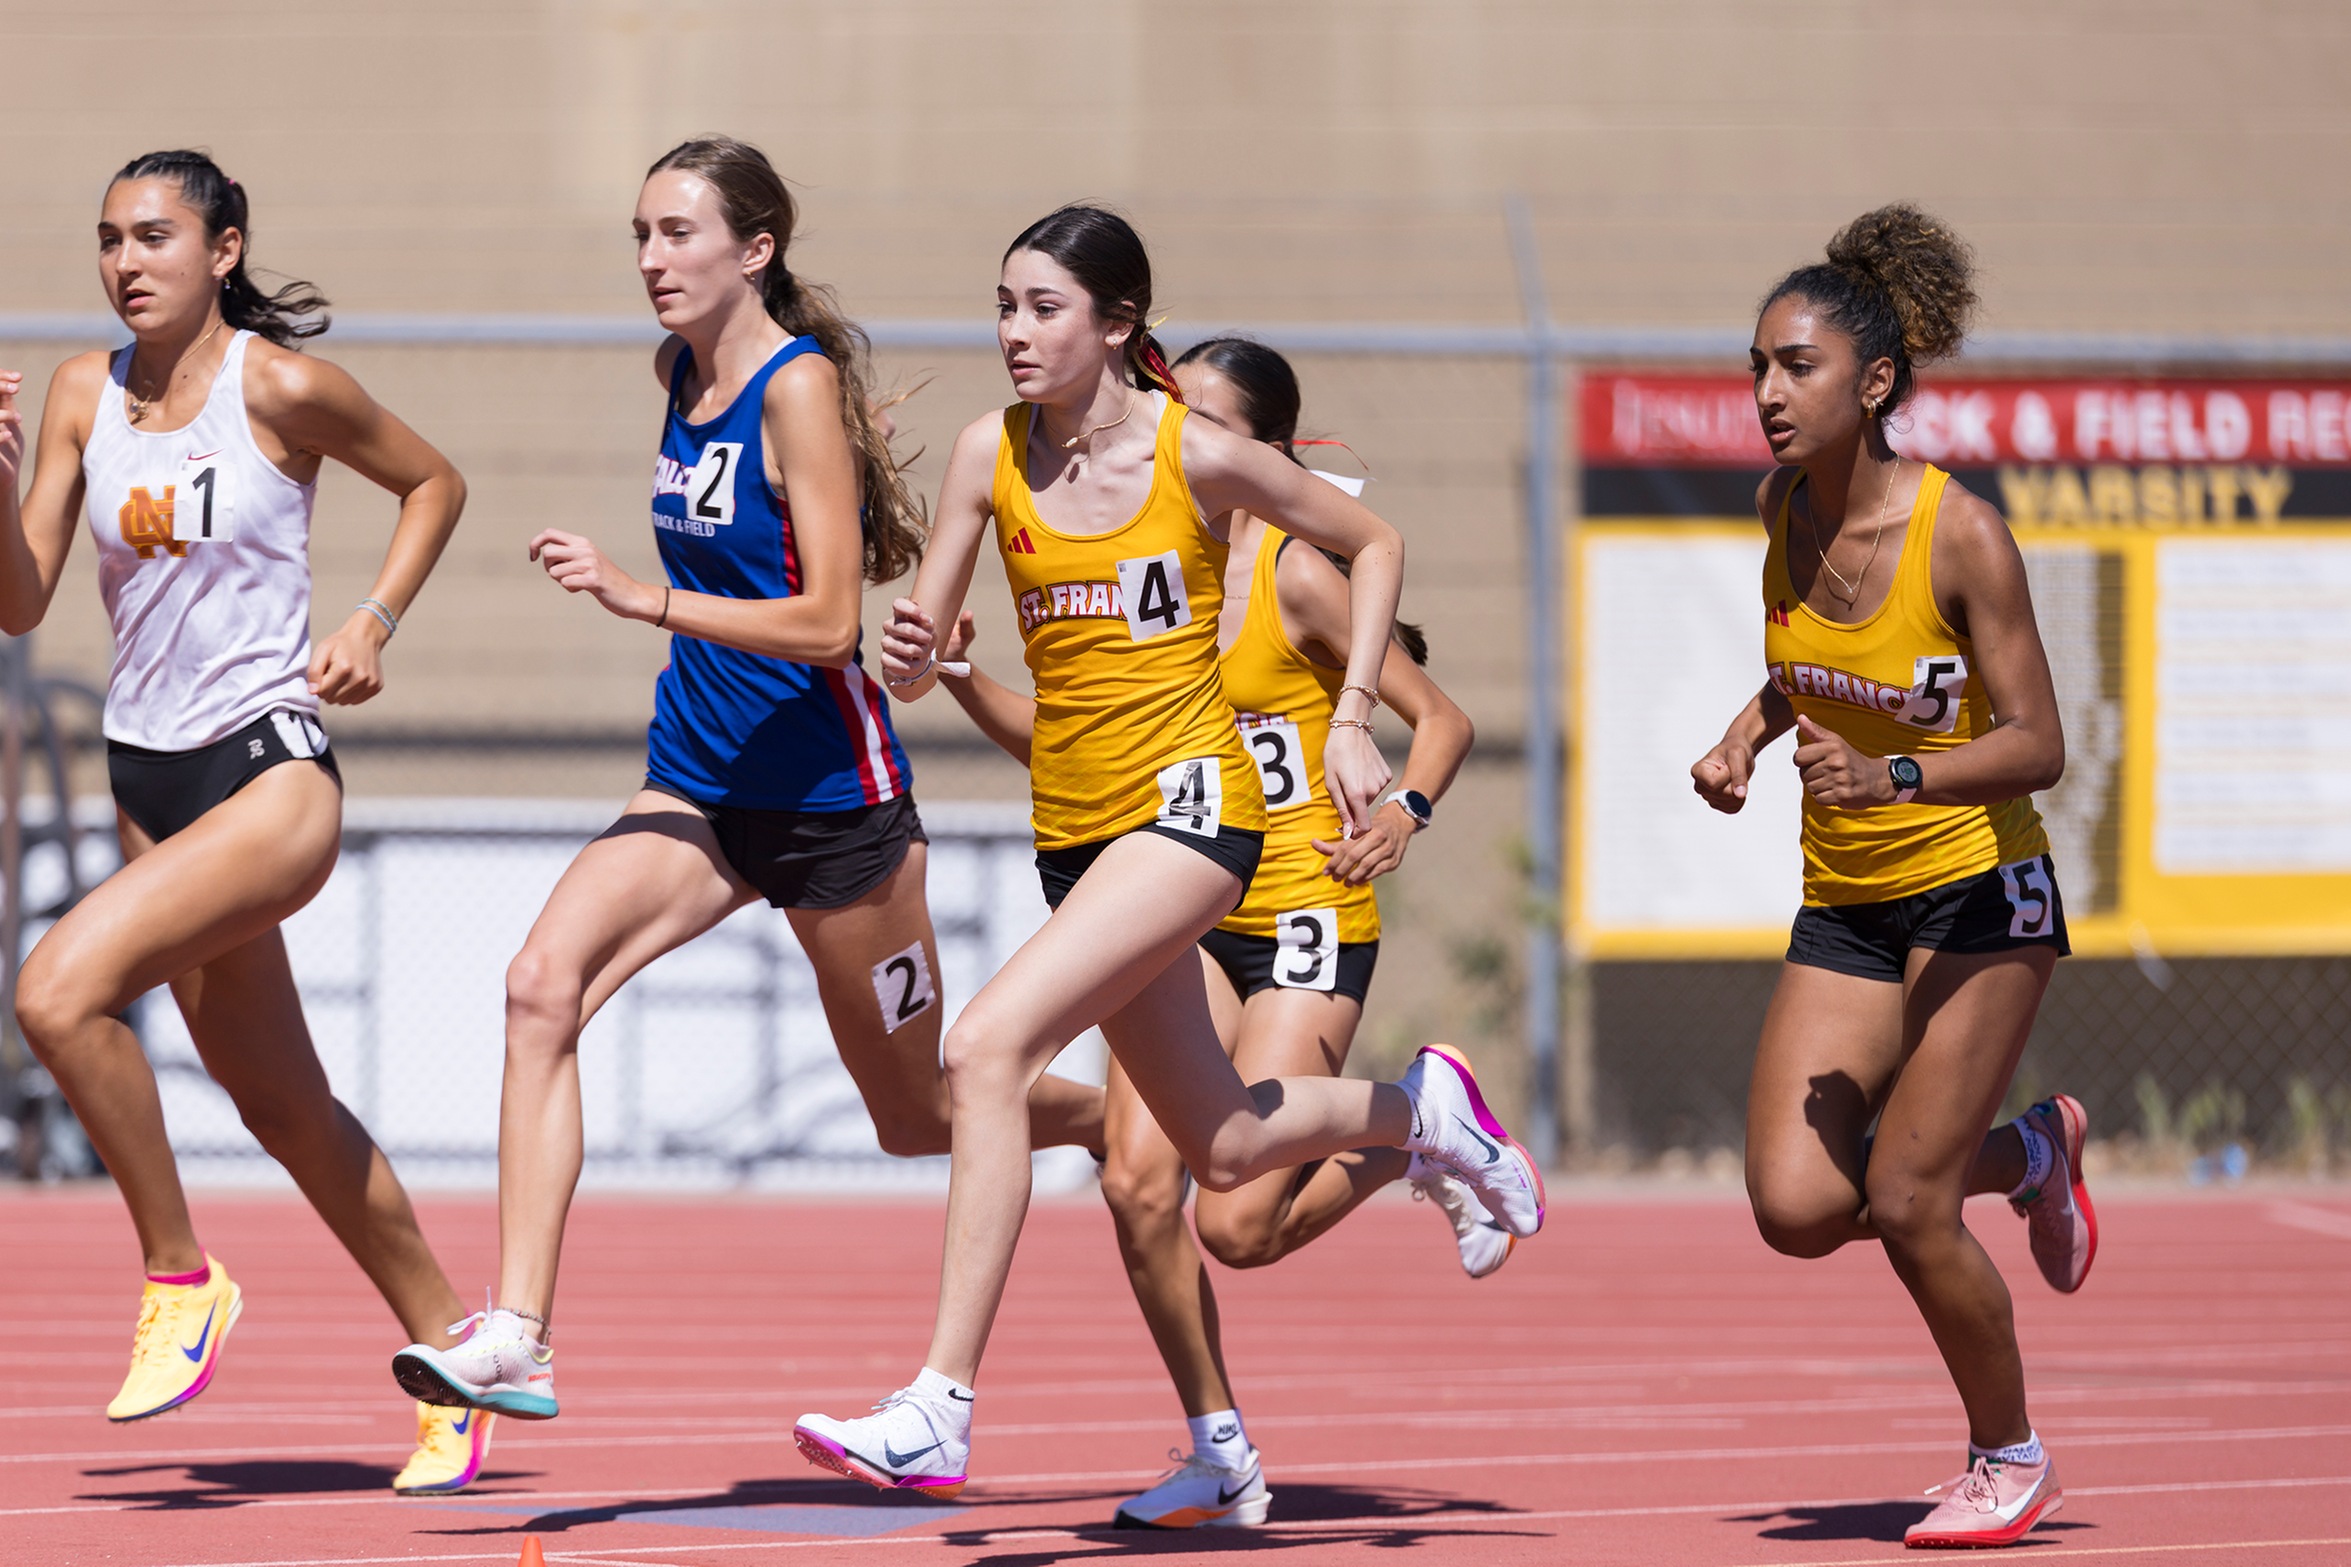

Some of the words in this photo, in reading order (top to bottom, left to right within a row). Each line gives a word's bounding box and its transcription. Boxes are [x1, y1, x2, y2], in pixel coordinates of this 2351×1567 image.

[2011, 389, 2058, 461] &
[2074, 389, 2252, 461] FIELD
[2267, 389, 2351, 461] RE
[192, 467, 216, 538] 1
[697, 447, 728, 519] 2
[1996, 464, 2293, 526] VARSITY
[684, 520, 716, 537] FIELD
[1019, 588, 1050, 632] ST.
[1047, 582, 1128, 619] FRAN
[1138, 561, 1180, 629] 4
[1792, 664, 1911, 713] FRANC
[1909, 663, 1956, 726] 5
[1169, 762, 1211, 830] 4
[1252, 732, 1294, 804] 3
[2012, 861, 2047, 933] 5
[1287, 915, 1323, 983] 3
[886, 956, 927, 1021] 2
